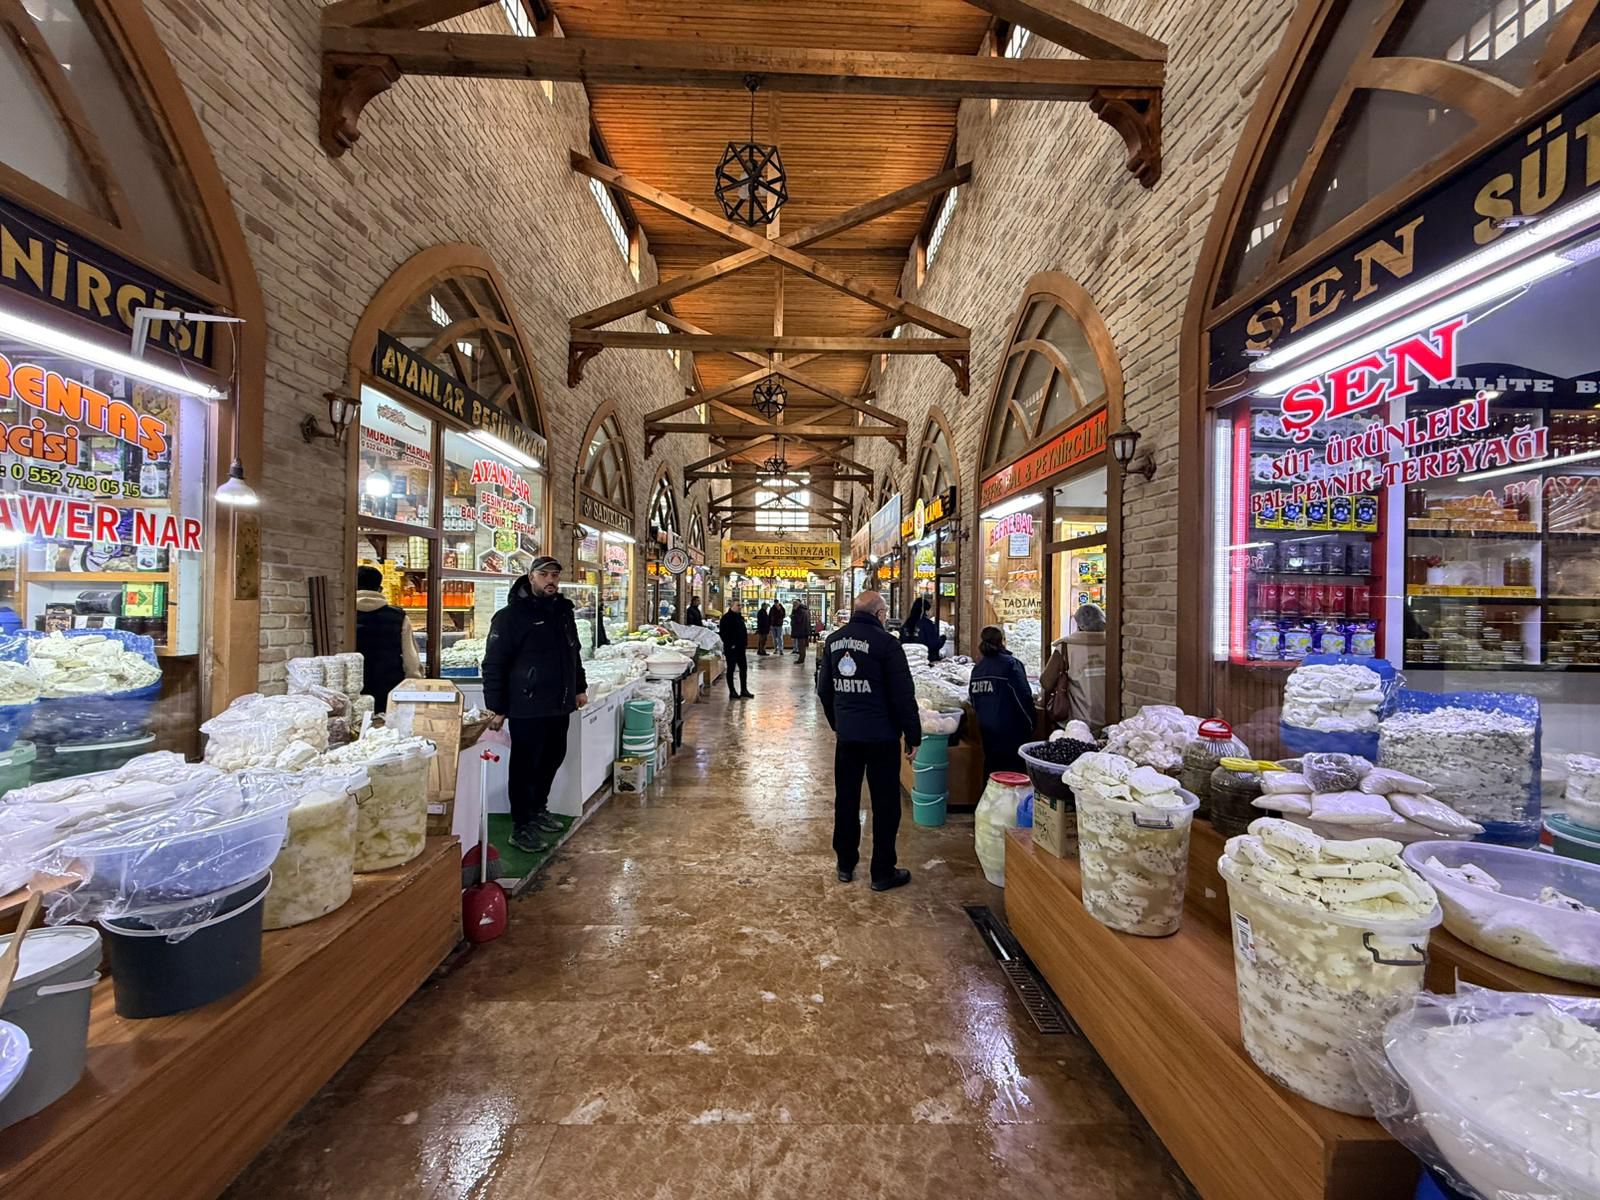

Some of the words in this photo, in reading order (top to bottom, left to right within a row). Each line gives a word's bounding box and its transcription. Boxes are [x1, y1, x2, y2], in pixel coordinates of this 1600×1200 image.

[1473, 114, 1600, 245] SÜT
[1281, 318, 1466, 442] ŞEN
[1576, 380, 1600, 394] B
[381, 345, 465, 417] AYANLAR
[472, 400, 511, 441] BESİN
[513, 425, 547, 463] PAZARI
[366, 428, 395, 447] MURAT
[406, 443, 431, 461] HARUN
[1026, 463, 1031, 481] &
[1035, 416, 1107, 478] PEYNİRCİLİK
[1272, 448, 1313, 480] SÜT
[1326, 390, 1490, 465] ÜRÜNLERİ
[11, 463, 24, 480] 0
[29, 466, 62, 485] 552
[68, 473, 96, 491] 718
[100, 480, 118, 495] 05
[123, 482, 141, 498] 15
[470, 460, 531, 503] AYANLAR
[1252, 425, 1548, 513] BAL-PEYNİR-TEREYAĞI
[461, 506, 475, 520] BAL
[1015, 514, 1033, 536] BAL
[135, 511, 201, 551] NAR
[744, 545, 770, 555] KAYA
[774, 543, 798, 555] BESİN
[800, 545, 833, 556] PAZARI
[745, 567, 771, 577] ÖRGÜ
[833, 678, 872, 694] ZABITA
